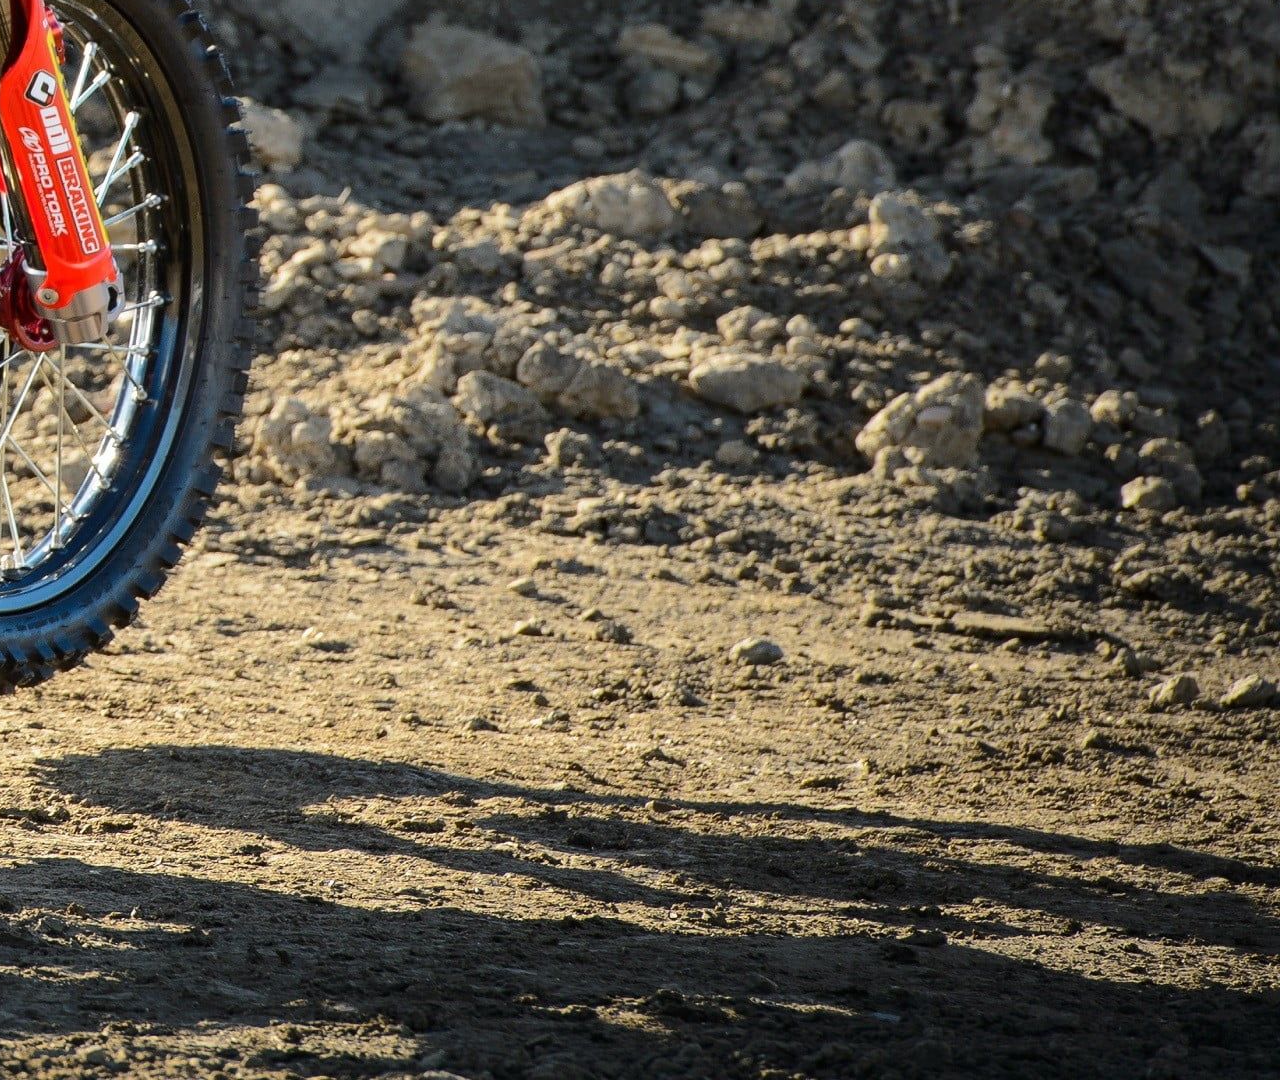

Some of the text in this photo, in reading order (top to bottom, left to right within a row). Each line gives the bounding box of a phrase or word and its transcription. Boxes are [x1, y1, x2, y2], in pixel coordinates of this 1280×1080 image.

[33, 152, 54, 189] PRO
[45, 189, 69, 237] TORK
[58, 159, 98, 252] BRAKING
